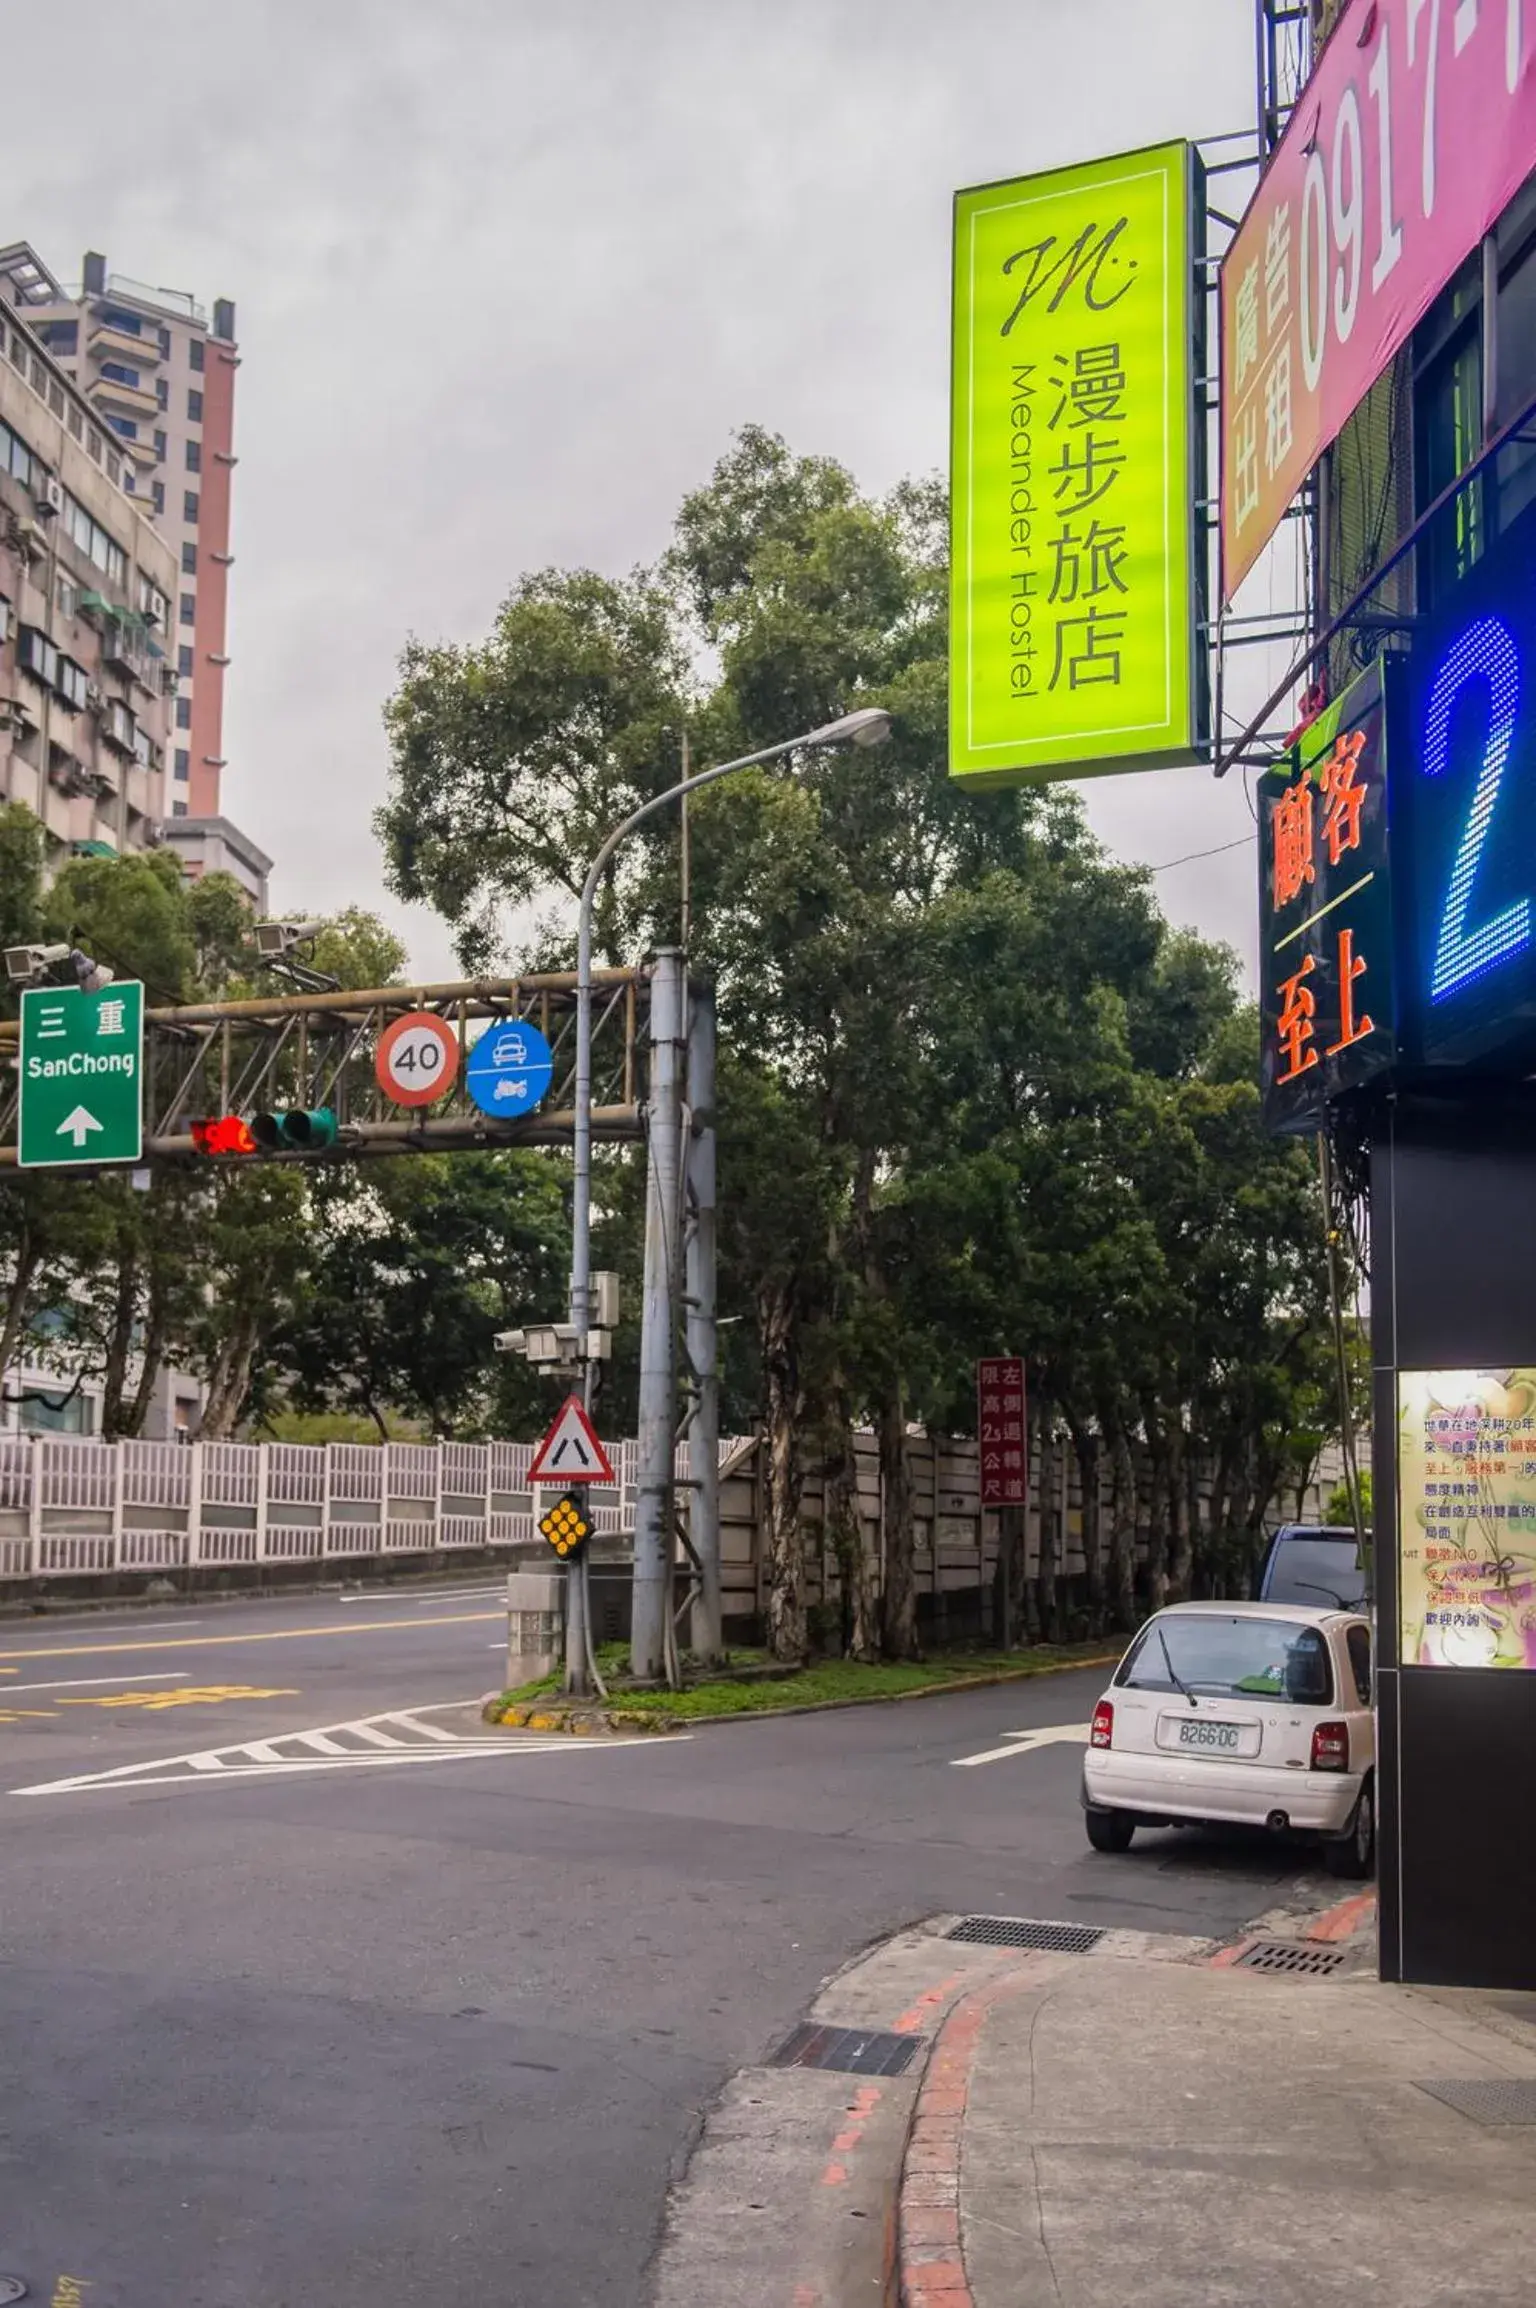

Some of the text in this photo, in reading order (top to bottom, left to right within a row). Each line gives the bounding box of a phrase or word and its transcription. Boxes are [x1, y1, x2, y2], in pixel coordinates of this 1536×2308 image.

[1234, 201, 1291, 394] 廣告
[1047, 342, 1128, 692] 漫步旅店
[1233, 338, 1293, 538] 出租
[1009, 365, 1039, 699] Meander Hostel
[1273, 729, 1367, 912] 顧客
[27, 1053, 135, 1078] SanChong
[37, 1000, 125, 1039] 三重
[395, 1043, 439, 1072] 40
[1276, 928, 1375, 1085] 至上
